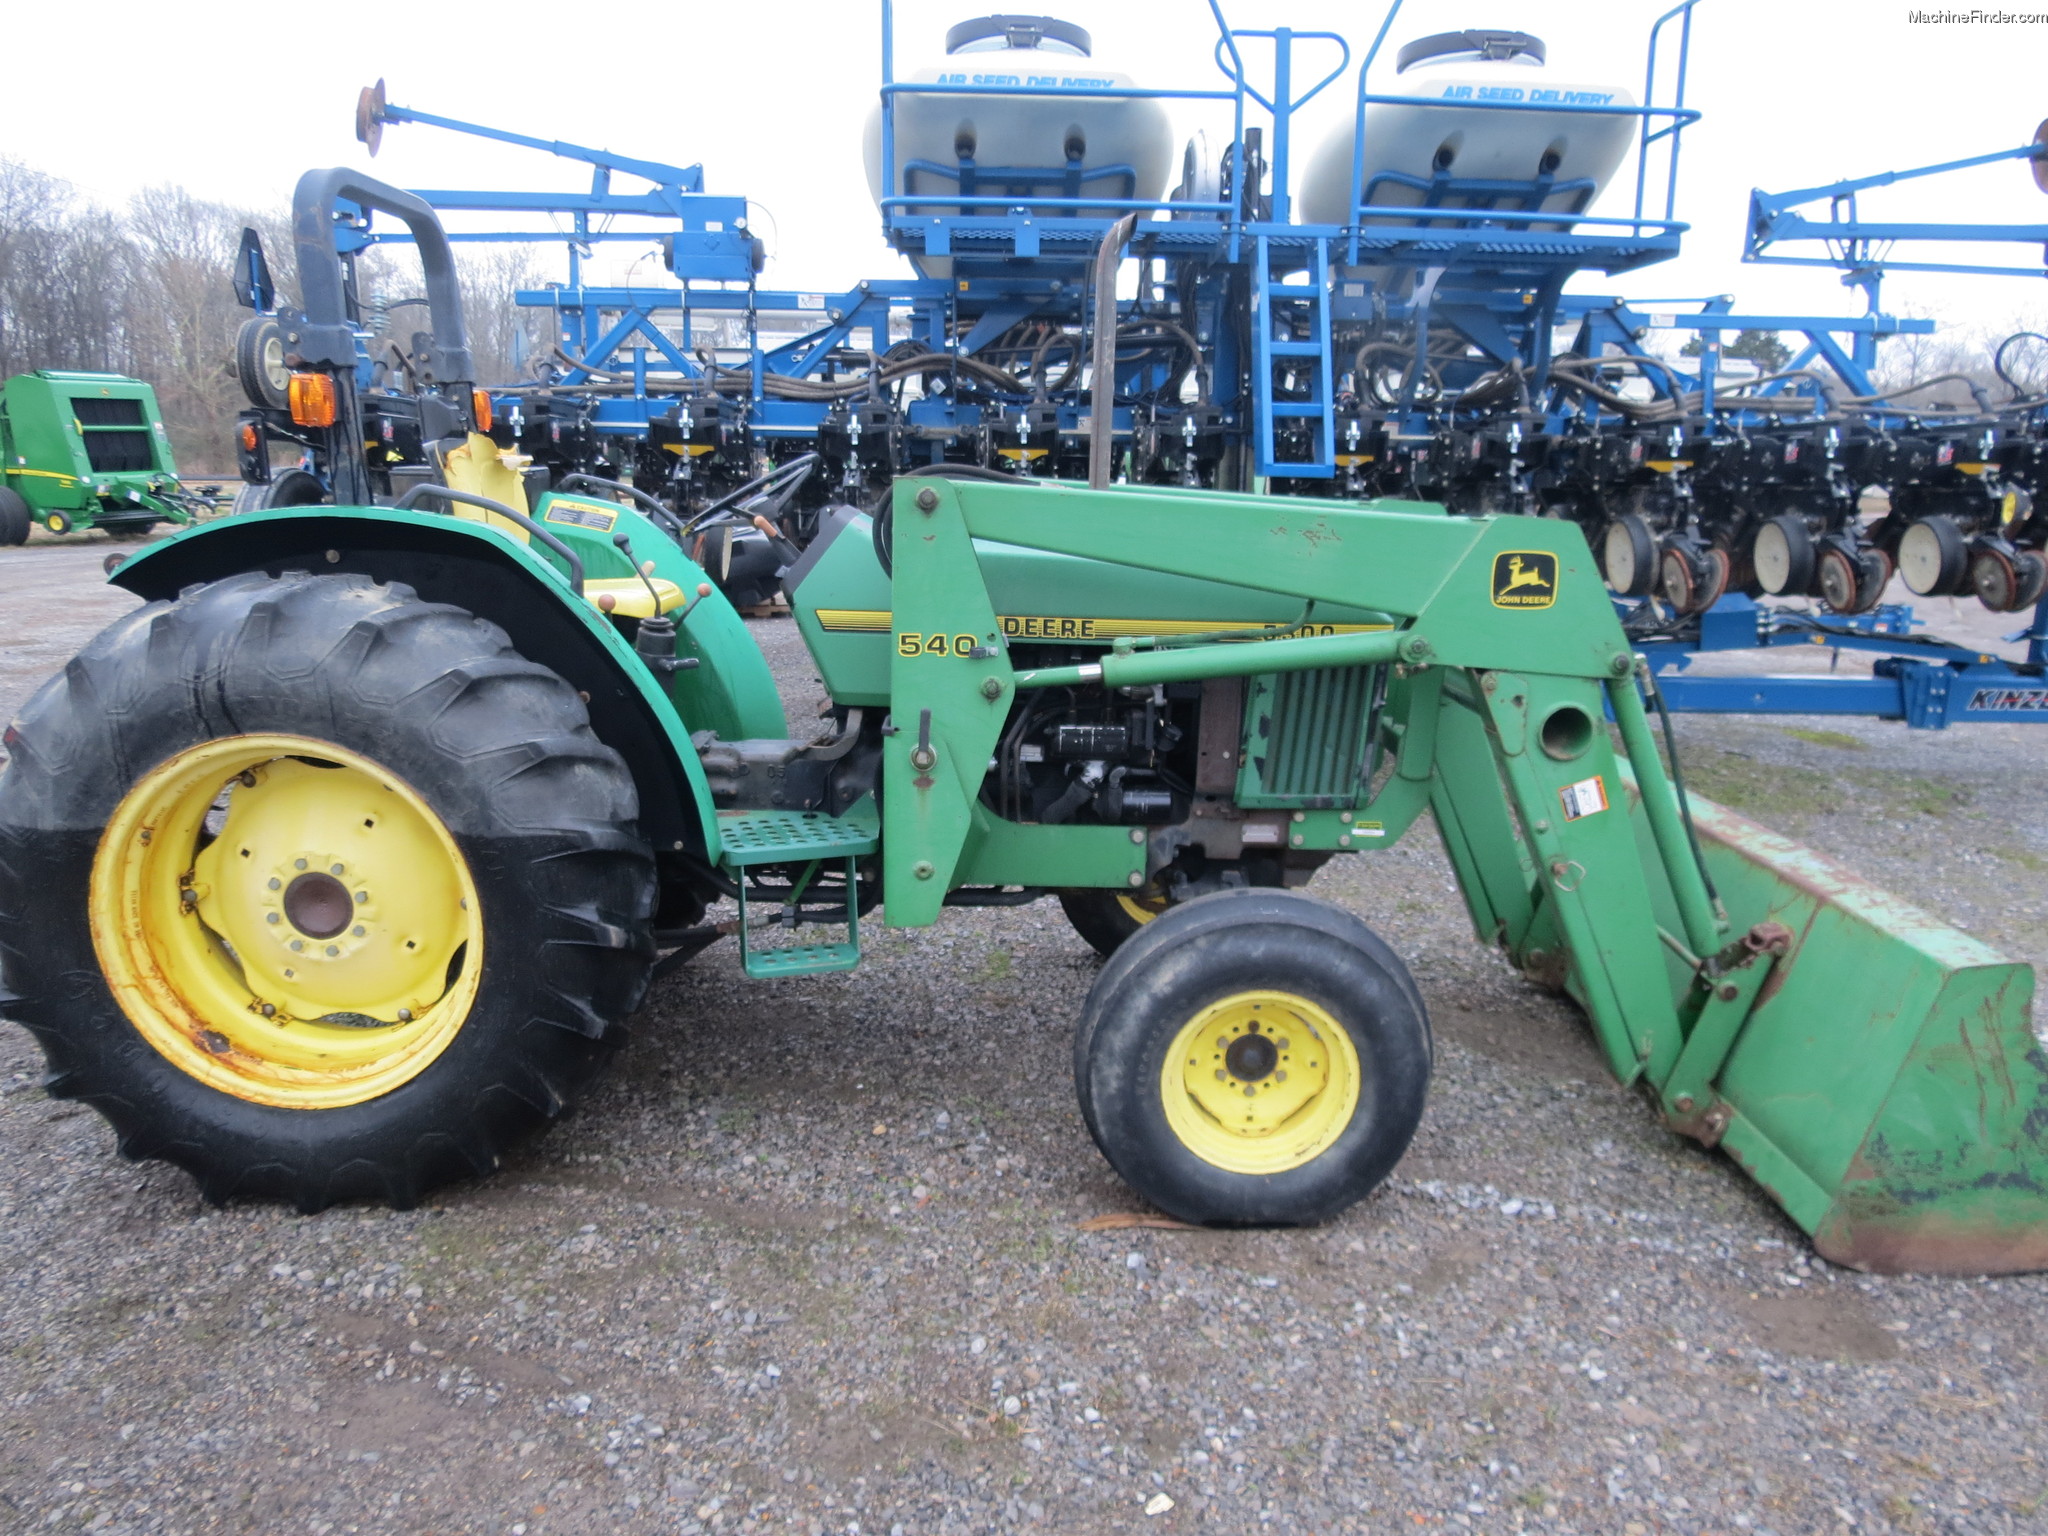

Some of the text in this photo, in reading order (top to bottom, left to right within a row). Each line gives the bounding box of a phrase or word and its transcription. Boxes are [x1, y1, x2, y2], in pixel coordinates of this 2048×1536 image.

[938, 74, 1115, 88] AIR SEED DELIVERY
[1442, 86, 1615, 104] AIR SEED DELIVERY
[1497, 596, 1551, 605] JOHN DEERE
[1003, 617, 1096, 638] DEERE
[899, 633, 977, 657] 540
